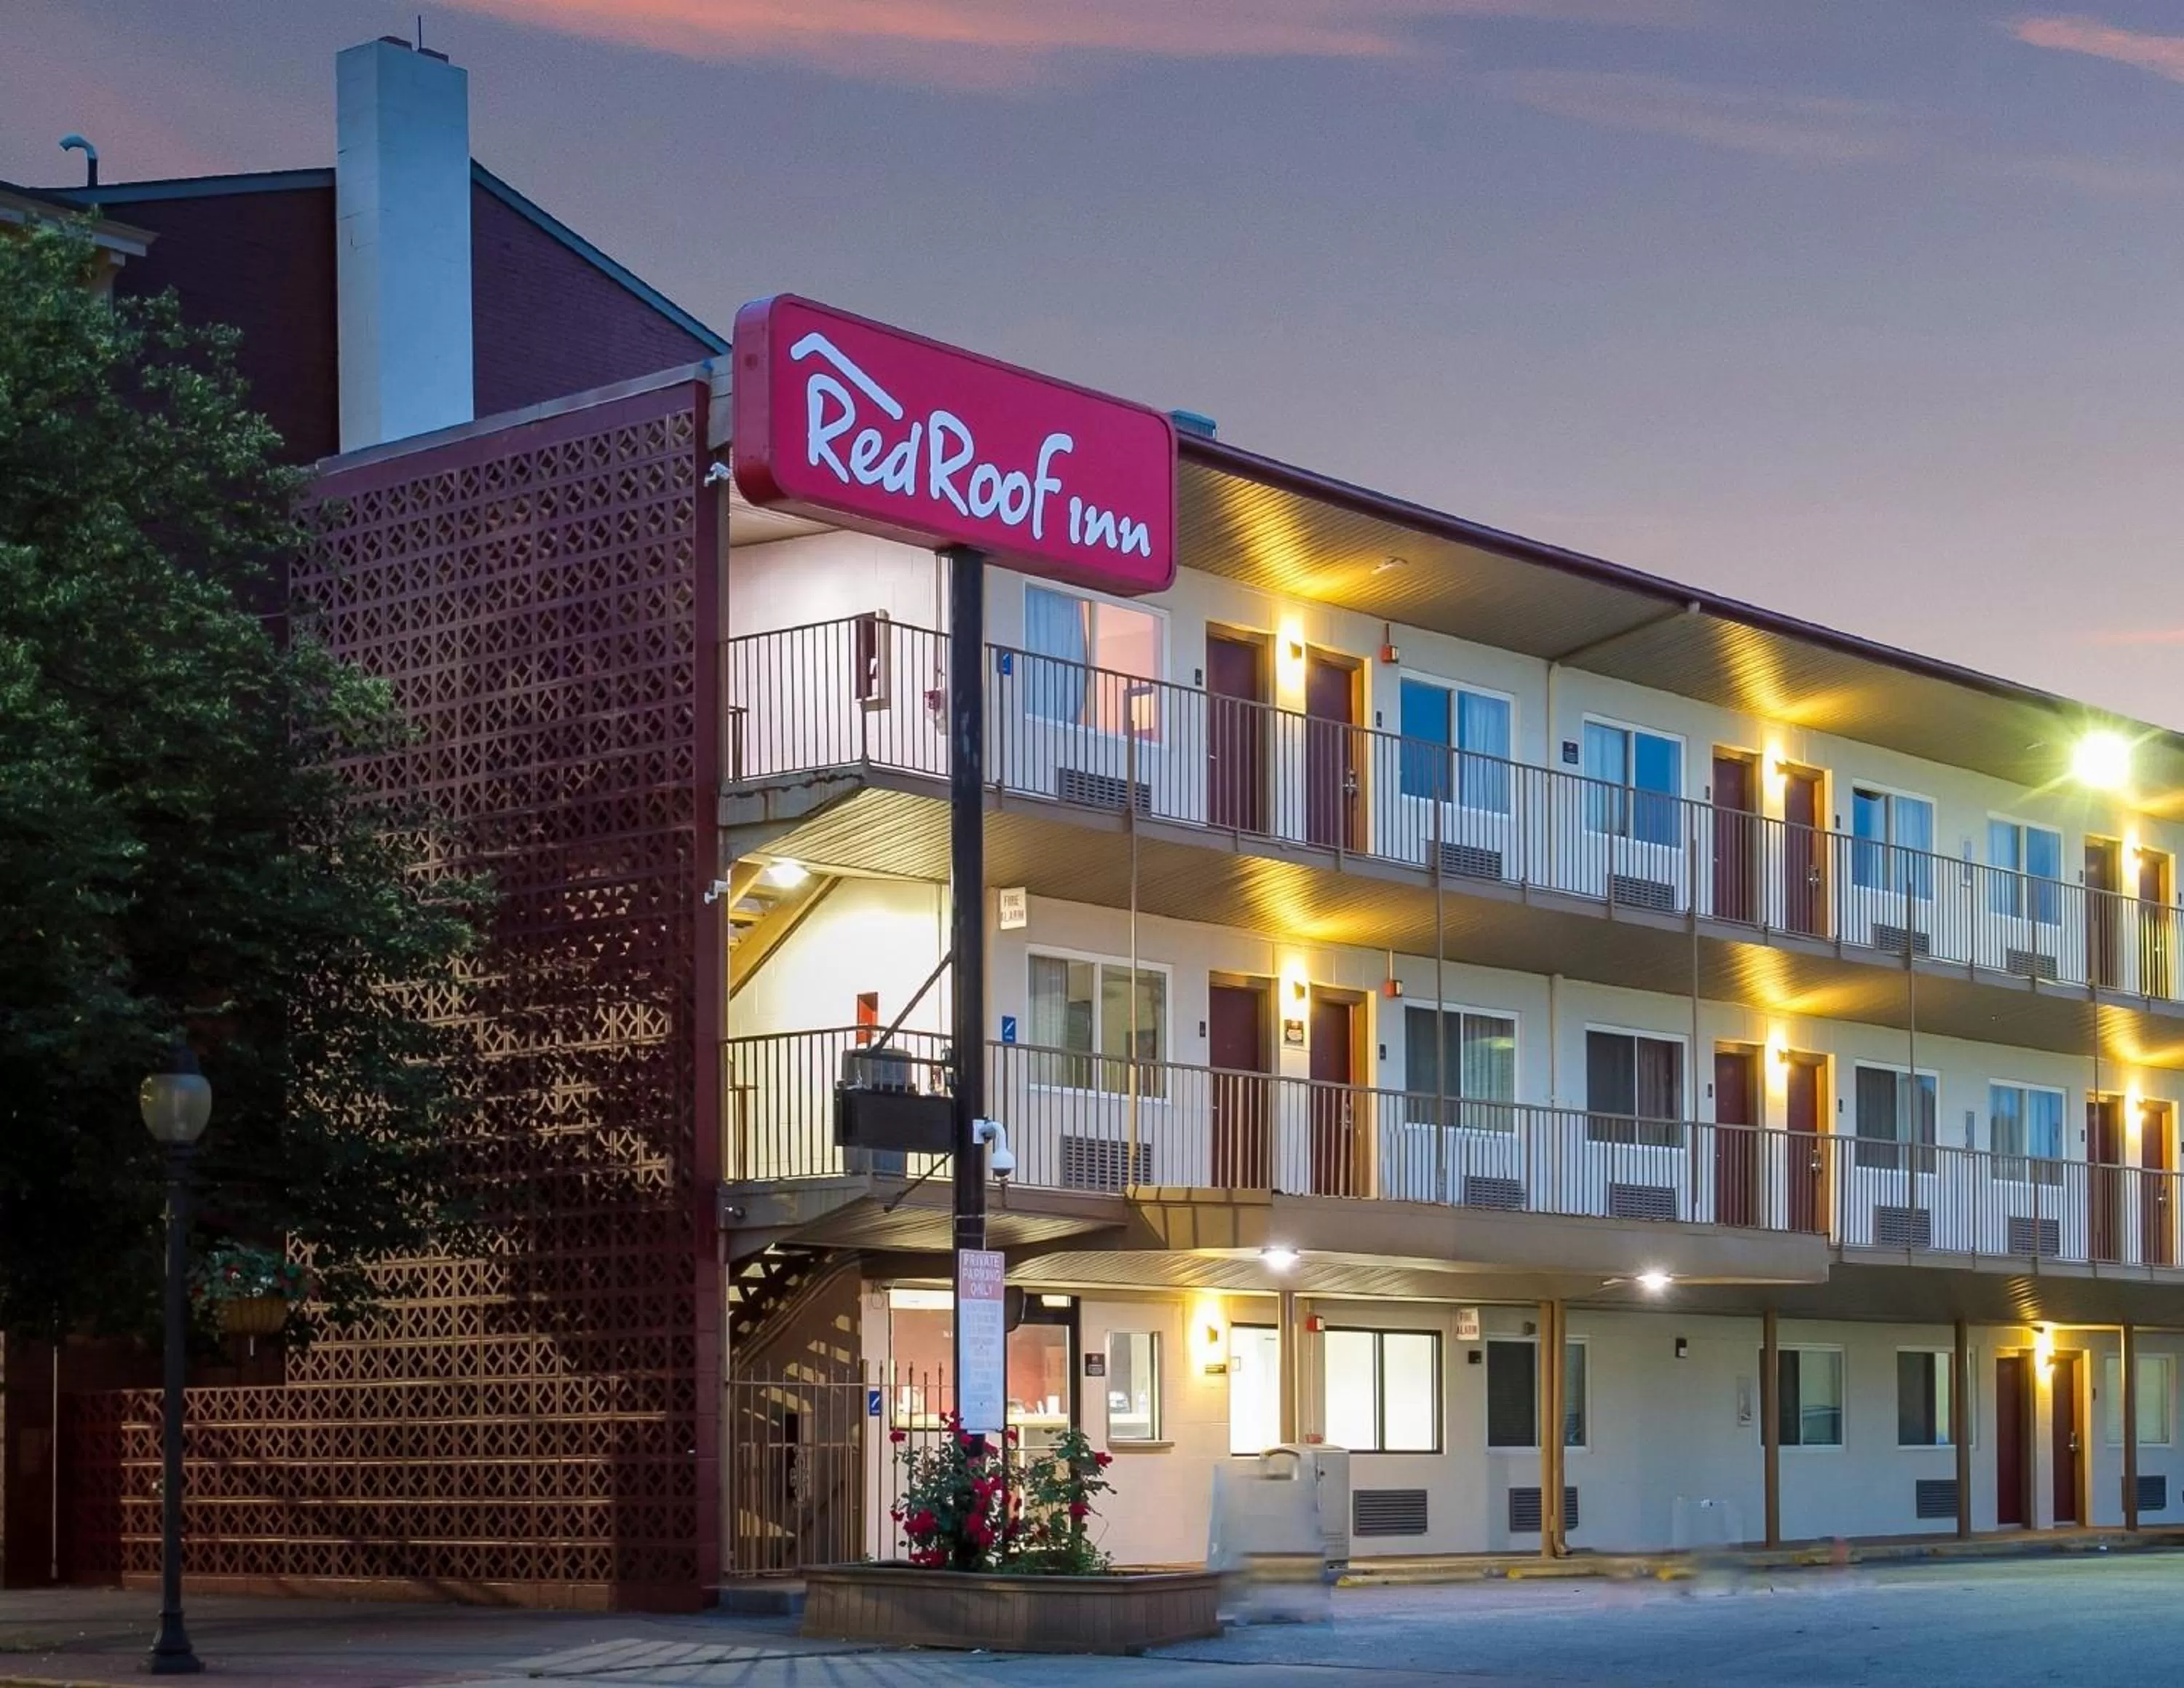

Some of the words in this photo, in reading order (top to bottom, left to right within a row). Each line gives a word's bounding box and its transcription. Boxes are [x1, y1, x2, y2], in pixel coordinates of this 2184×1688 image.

[807, 374, 922, 496] Red
[929, 409, 1074, 540] Roof
[963, 1253, 1000, 1268] PRIVATE
[962, 1267, 1002, 1282] PARKING
[970, 1282, 993, 1297] ONLY
